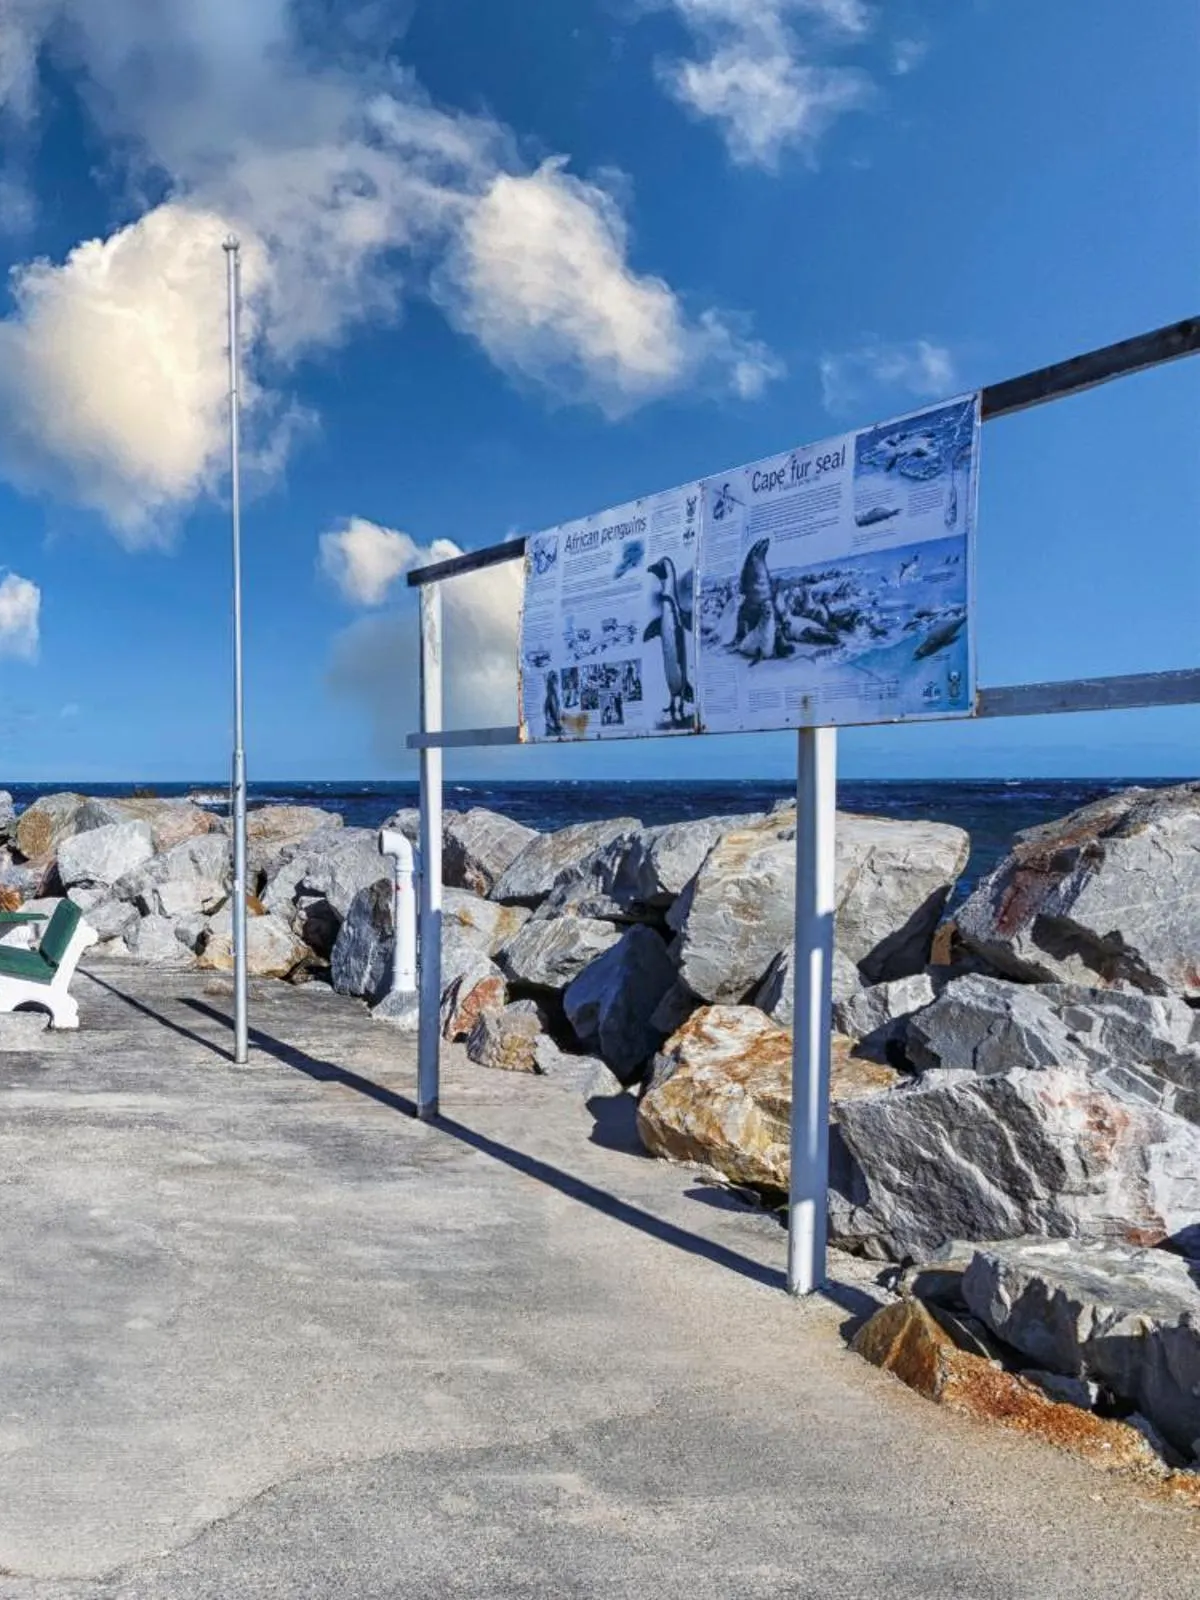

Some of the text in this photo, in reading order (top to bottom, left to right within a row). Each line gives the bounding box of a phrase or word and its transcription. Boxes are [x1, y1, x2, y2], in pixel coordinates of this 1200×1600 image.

[752, 467, 785, 493] Cape
[790, 454, 812, 481] fur
[815, 444, 846, 475] seal
[564, 529, 599, 550] African
[601, 516, 647, 544] penguins
